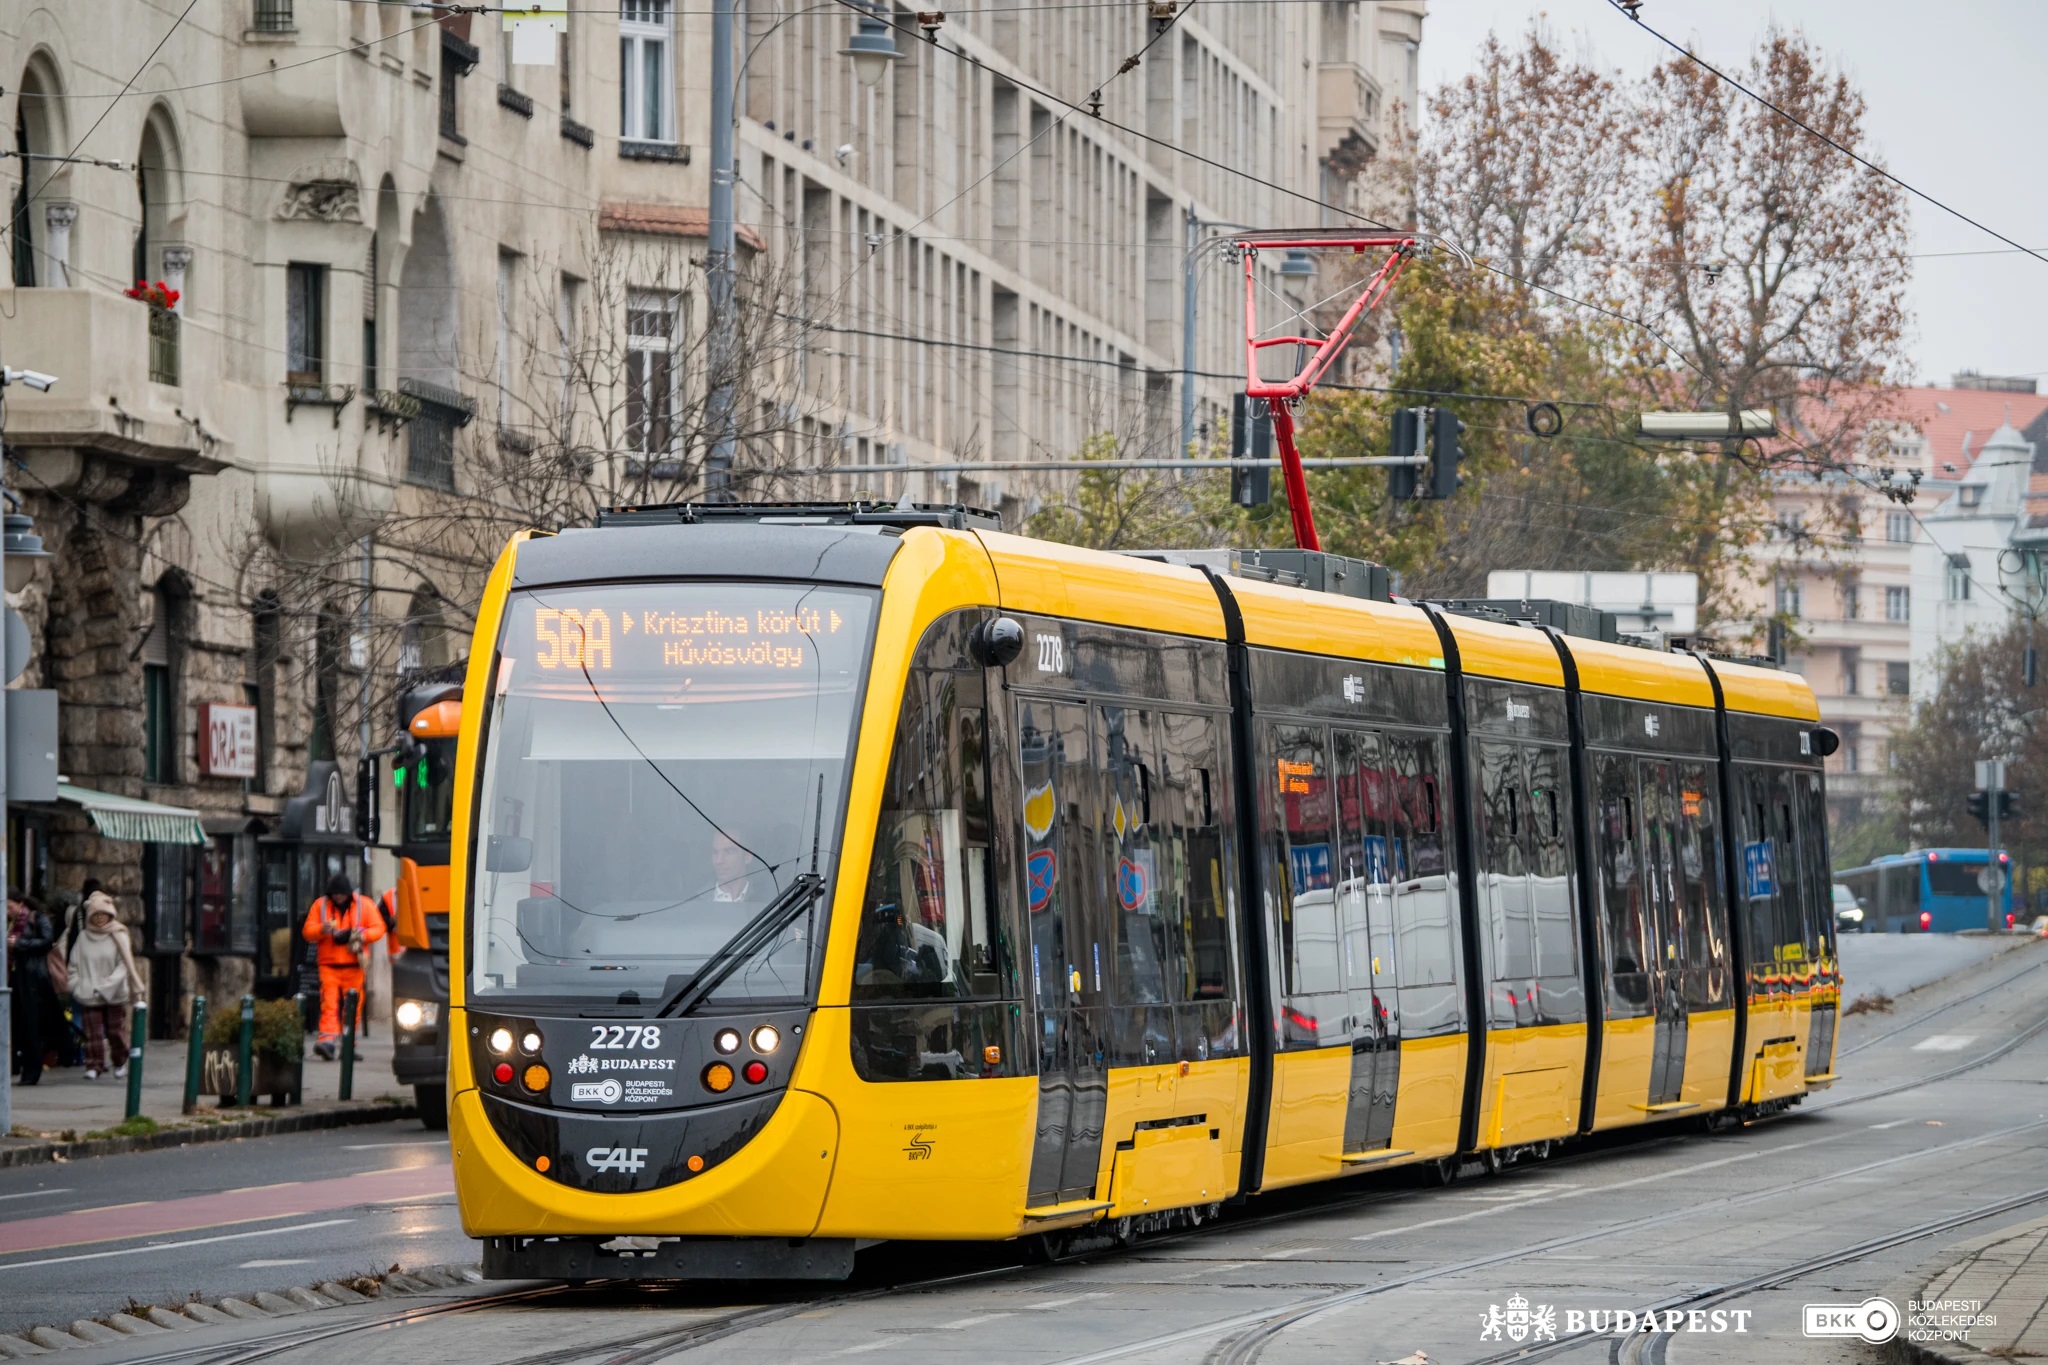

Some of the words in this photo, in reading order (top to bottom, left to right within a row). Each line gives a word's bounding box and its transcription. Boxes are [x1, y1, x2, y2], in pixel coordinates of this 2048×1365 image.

[536, 608, 611, 668] 56A
[644, 611, 748, 634] Krisztina
[758, 607, 820, 633] körút
[664, 639, 803, 668] Hűvösvölgy
[1036, 633, 1063, 673] 2278
[589, 1025, 661, 1050] 2278
[601, 1059, 676, 1070] BUDAPEST
[578, 1088, 599, 1096] BKK
[625, 1087, 673, 1095] KÖZLEKEDÉSI
[625, 1095, 659, 1103] KÖZPONT
[586, 1147, 649, 1174] CAF
